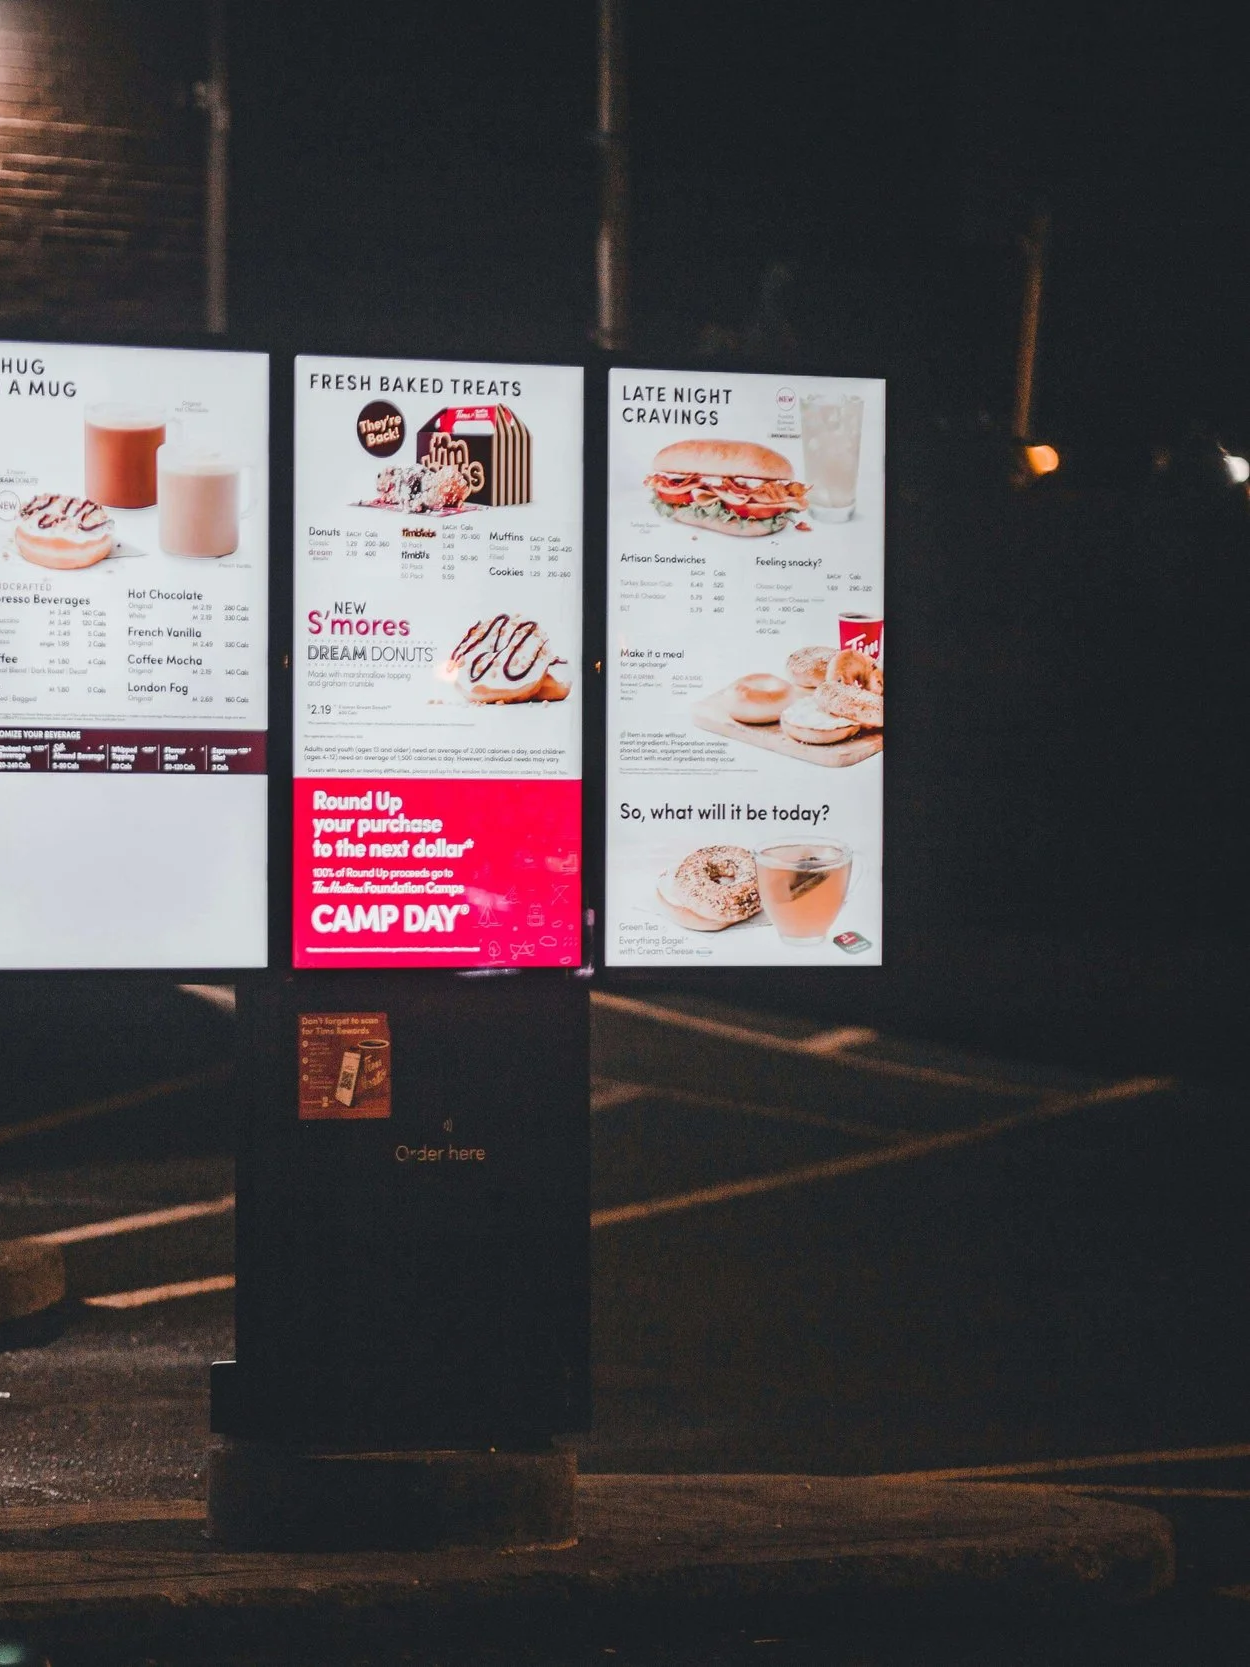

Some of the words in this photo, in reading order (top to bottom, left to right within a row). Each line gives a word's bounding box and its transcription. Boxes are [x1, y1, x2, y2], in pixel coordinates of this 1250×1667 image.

[2, 358, 45, 375] HUG
[9, 380, 21, 395] A
[29, 380, 77, 398] MUG
[310, 373, 371, 391] FRESH
[379, 376, 444, 394] BAKED
[450, 379, 522, 396] TREATS
[623, 385, 666, 402] LATE
[674, 387, 732, 404] NIGHT
[622, 408, 719, 426] CRAVINGS
[359, 415, 401, 434] They're
[367, 429, 400, 447] Back!
[309, 526, 340, 537] Donuts
[490, 532, 524, 541] Muffins
[401, 551, 429, 560] timbits
[620, 554, 652, 562] Artisan
[654, 554, 706, 564] Sandwiches
[756, 557, 786, 568] Feeling
[789, 559, 822, 569] snacky?
[489, 567, 524, 576] Cookies
[34, 594, 90, 607] Beverages
[128, 589, 146, 599] Hot
[150, 589, 203, 600] Chocolate
[335, 602, 366, 615] NEW
[308, 610, 410, 636] S'mores
[128, 627, 163, 637] French
[167, 627, 201, 638] Vanilla
[308, 645, 367, 660] DREAM
[620, 649, 644, 658] Make
[647, 649, 652, 658] it
[663, 650, 684, 658] meal
[128, 654, 163, 664] Coffee
[167, 655, 202, 665] Mocha
[387, 672, 411, 681] topping
[128, 682, 166, 692] London
[170, 683, 189, 695] Fog
[23, 730, 43, 739] YOUR
[44, 730, 81, 740] BEVERAGE
[312, 790, 372, 811] Round
[376, 791, 402, 815] Up
[620, 803, 645, 822] So,
[651, 803, 692, 820] what
[698, 804, 725, 820] will
[731, 805, 741, 820] it
[747, 805, 767, 820] be
[772, 804, 830, 825] today?
[312, 817, 355, 838] your
[357, 814, 443, 838] purchase
[312, 840, 333, 858] to
[336, 838, 367, 858] the
[369, 839, 409, 858] next
[336, 867, 345, 878] of
[346, 867, 375, 878] Round
[376, 867, 389, 880] Up
[390, 867, 430, 880] proceeds
[432, 870, 444, 881] go
[444, 869, 453, 879] to
[364, 882, 425, 894] Foundation
[425, 882, 465, 897] Camps
[311, 904, 399, 933] CAMP
[619, 923, 642, 931] Green
[645, 923, 658, 931] Tea
[619, 937, 659, 947] Everything
[661, 937, 684, 947] Bagel
[395, 1145, 444, 1162] Order
[449, 1145, 486, 1162] here
